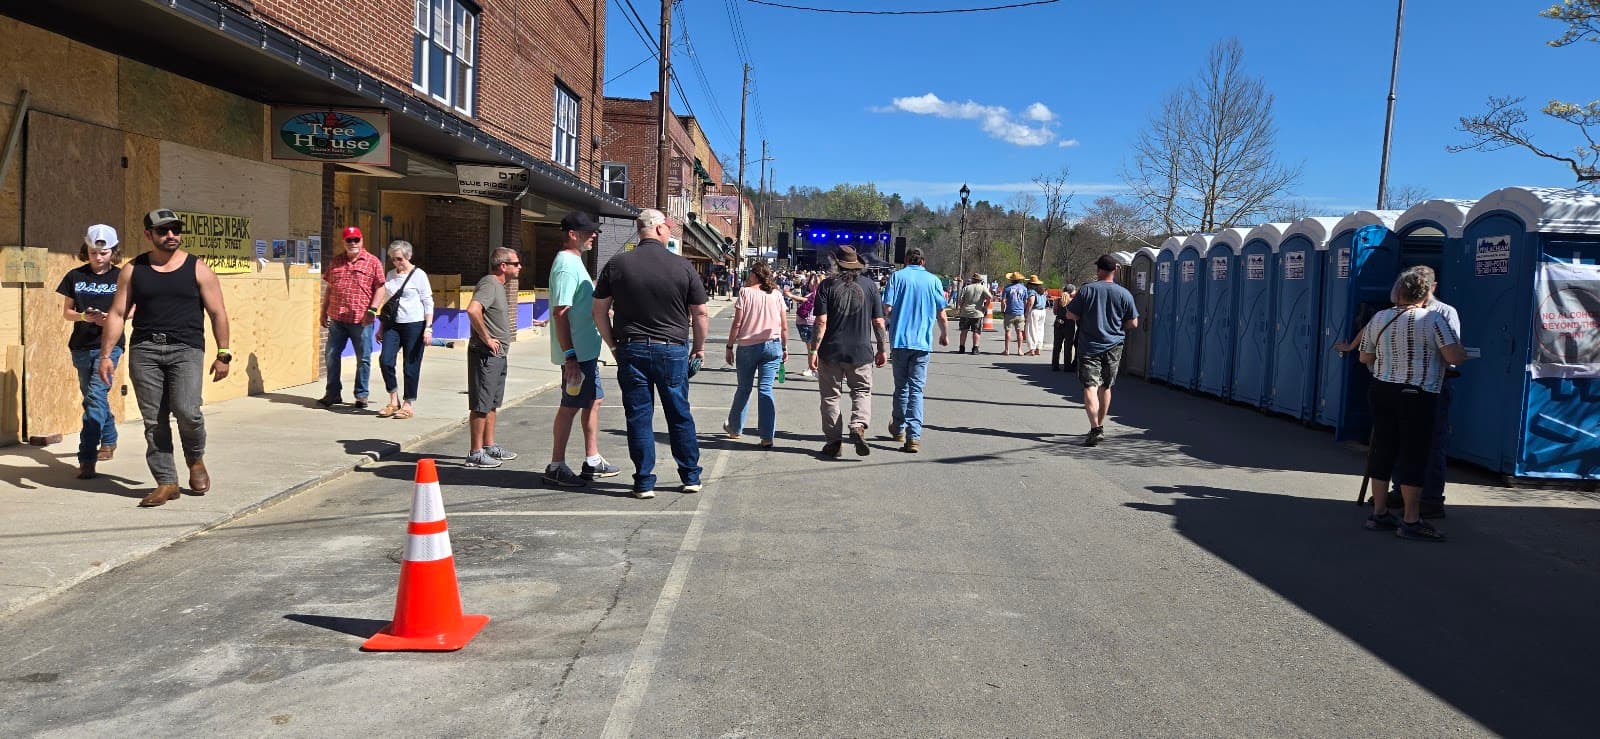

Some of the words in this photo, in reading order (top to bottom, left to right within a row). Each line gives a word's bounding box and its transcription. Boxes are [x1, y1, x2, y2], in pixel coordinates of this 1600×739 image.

[307, 122, 355, 137] Tree
[293, 133, 370, 149] House
[483, 181, 509, 189] RIDGE
[178, 213, 224, 236] ELIVERIES
[231, 217, 250, 239] BACK
[199, 237, 222, 249] LOCUST
[224, 238, 242, 249] STREET
[1542, 312, 1555, 320] NO
[1542, 321, 1580, 330] BEYOND
